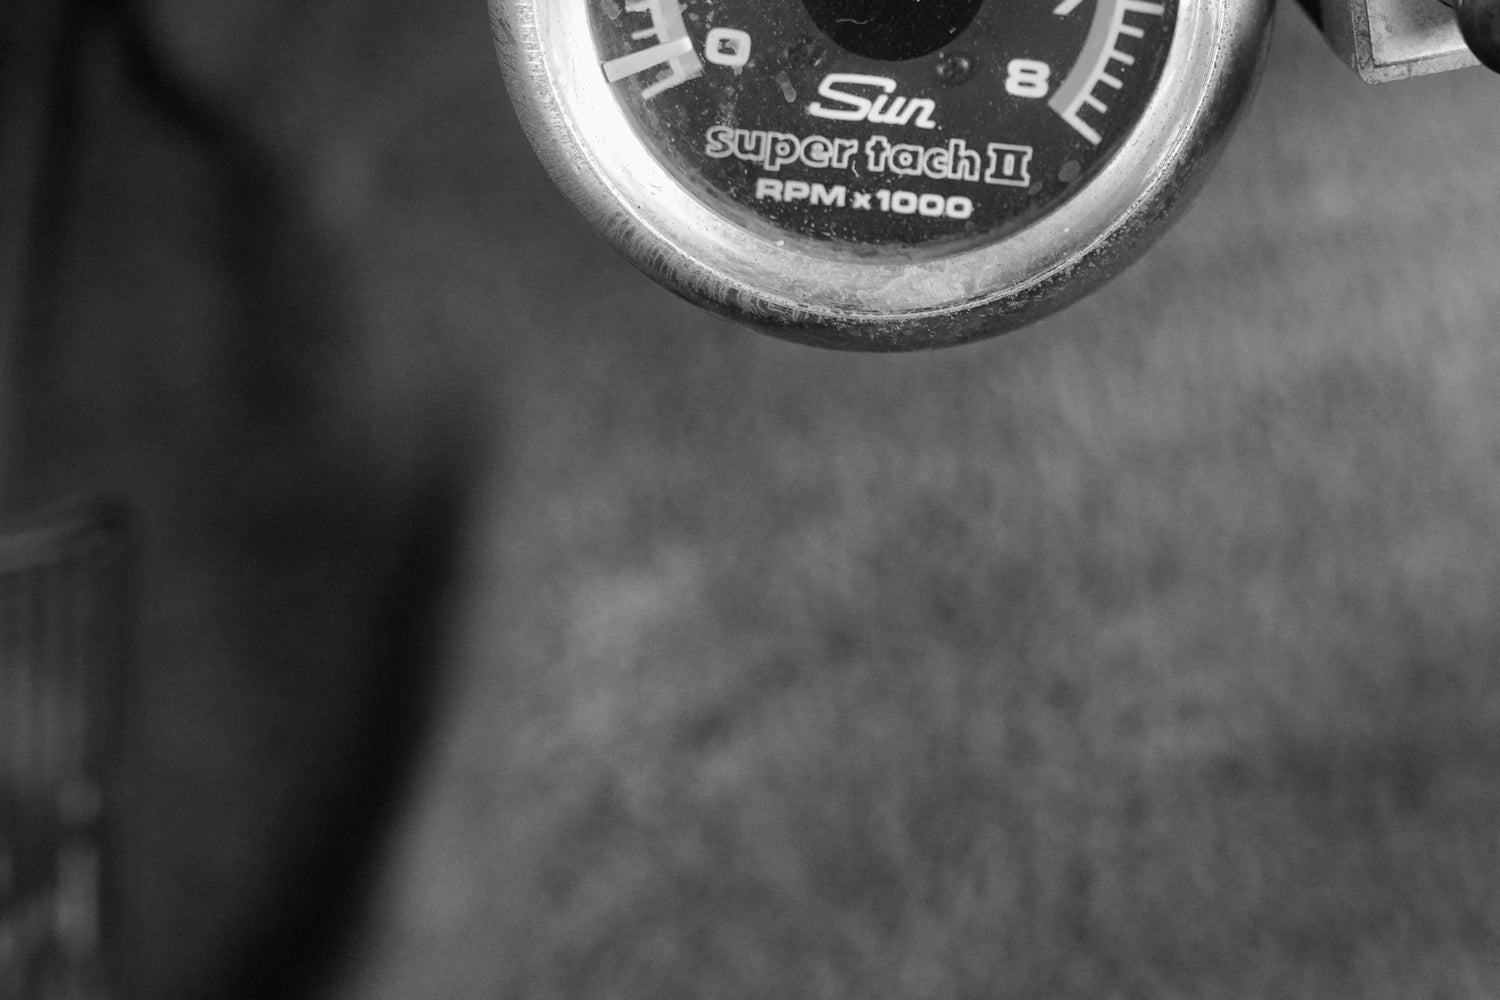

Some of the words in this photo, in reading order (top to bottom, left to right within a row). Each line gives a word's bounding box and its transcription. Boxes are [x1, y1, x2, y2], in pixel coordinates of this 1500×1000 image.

[705, 28, 750, 66] 0
[1005, 59, 1050, 98] 8
[806, 73, 936, 129] Sun
[705, 125, 858, 171] super
[865, 136, 981, 182] tach
[755, 178, 847, 207] RPM
[876, 190, 973, 219] 1000
